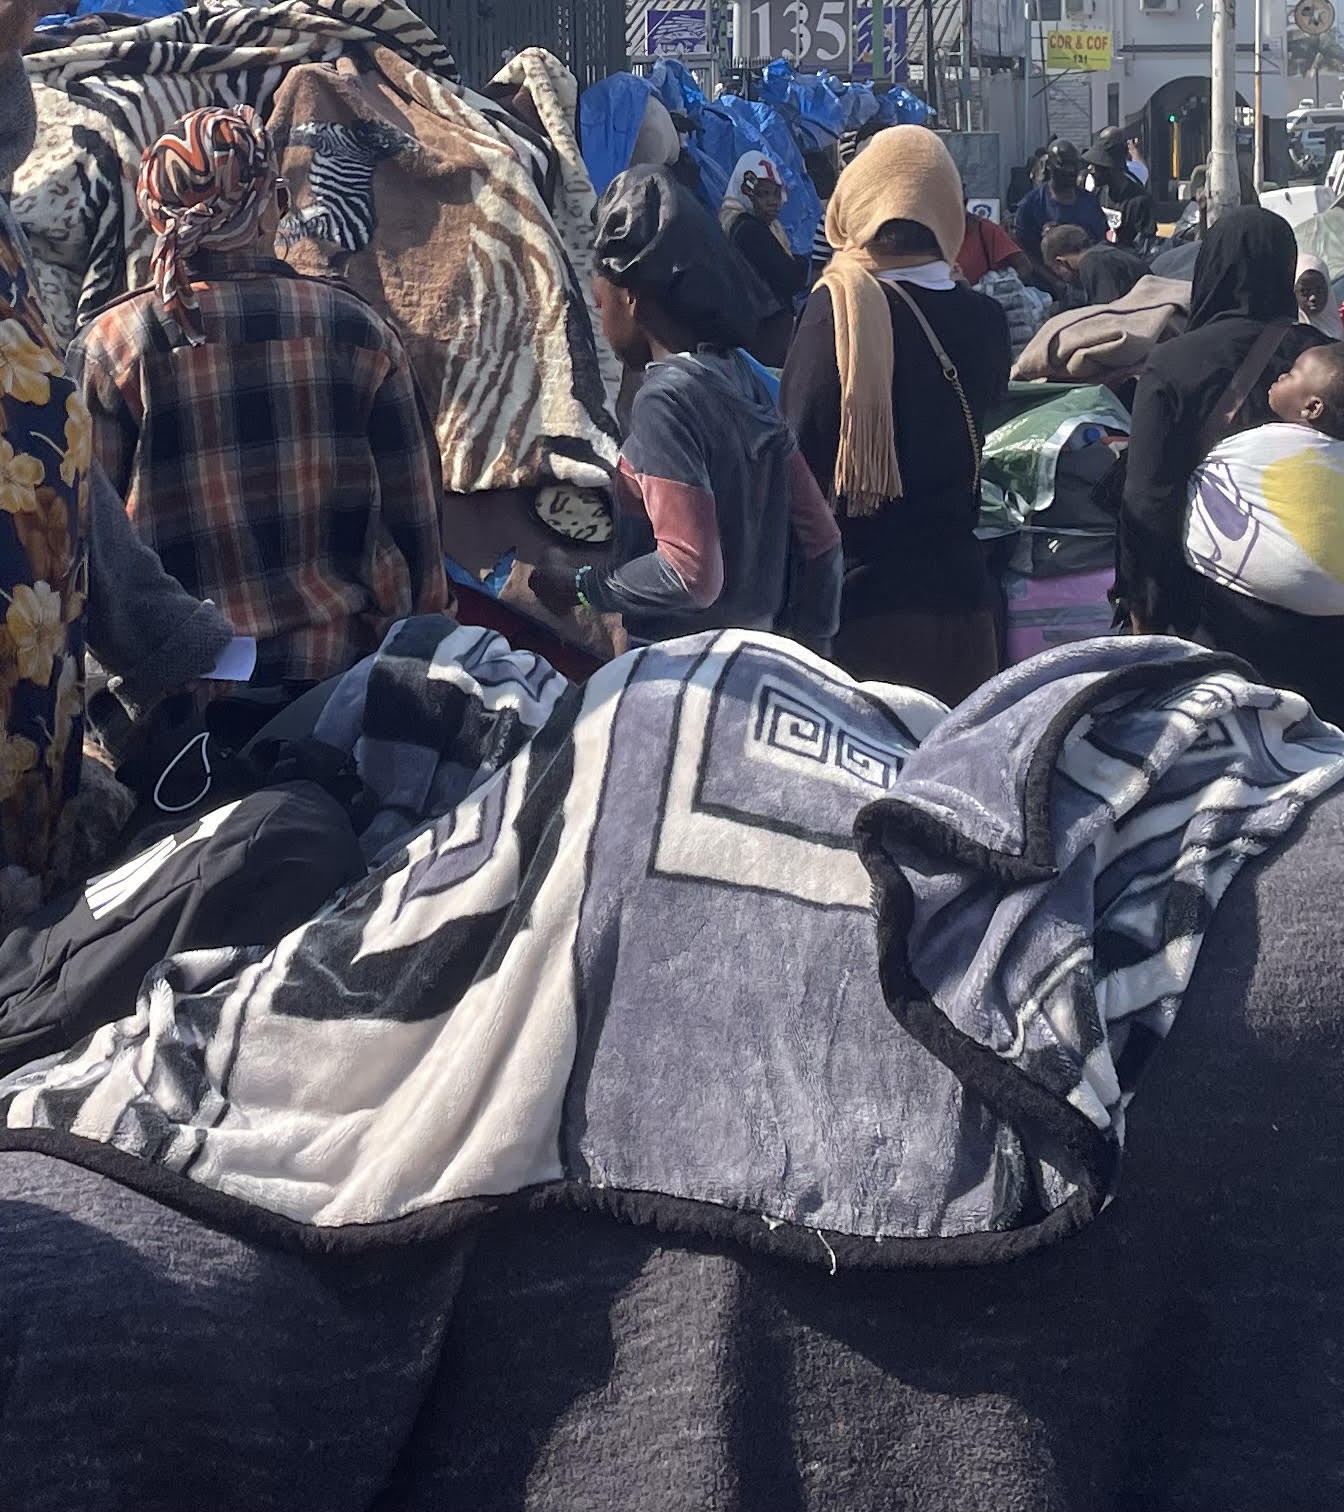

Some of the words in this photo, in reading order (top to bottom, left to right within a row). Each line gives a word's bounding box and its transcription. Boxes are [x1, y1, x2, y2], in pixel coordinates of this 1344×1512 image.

[752, 1, 846, 61] 135
[1049, 35, 1072, 49] COR
[1075, 35, 1082, 49] &
[1087, 36, 1108, 50] COF
